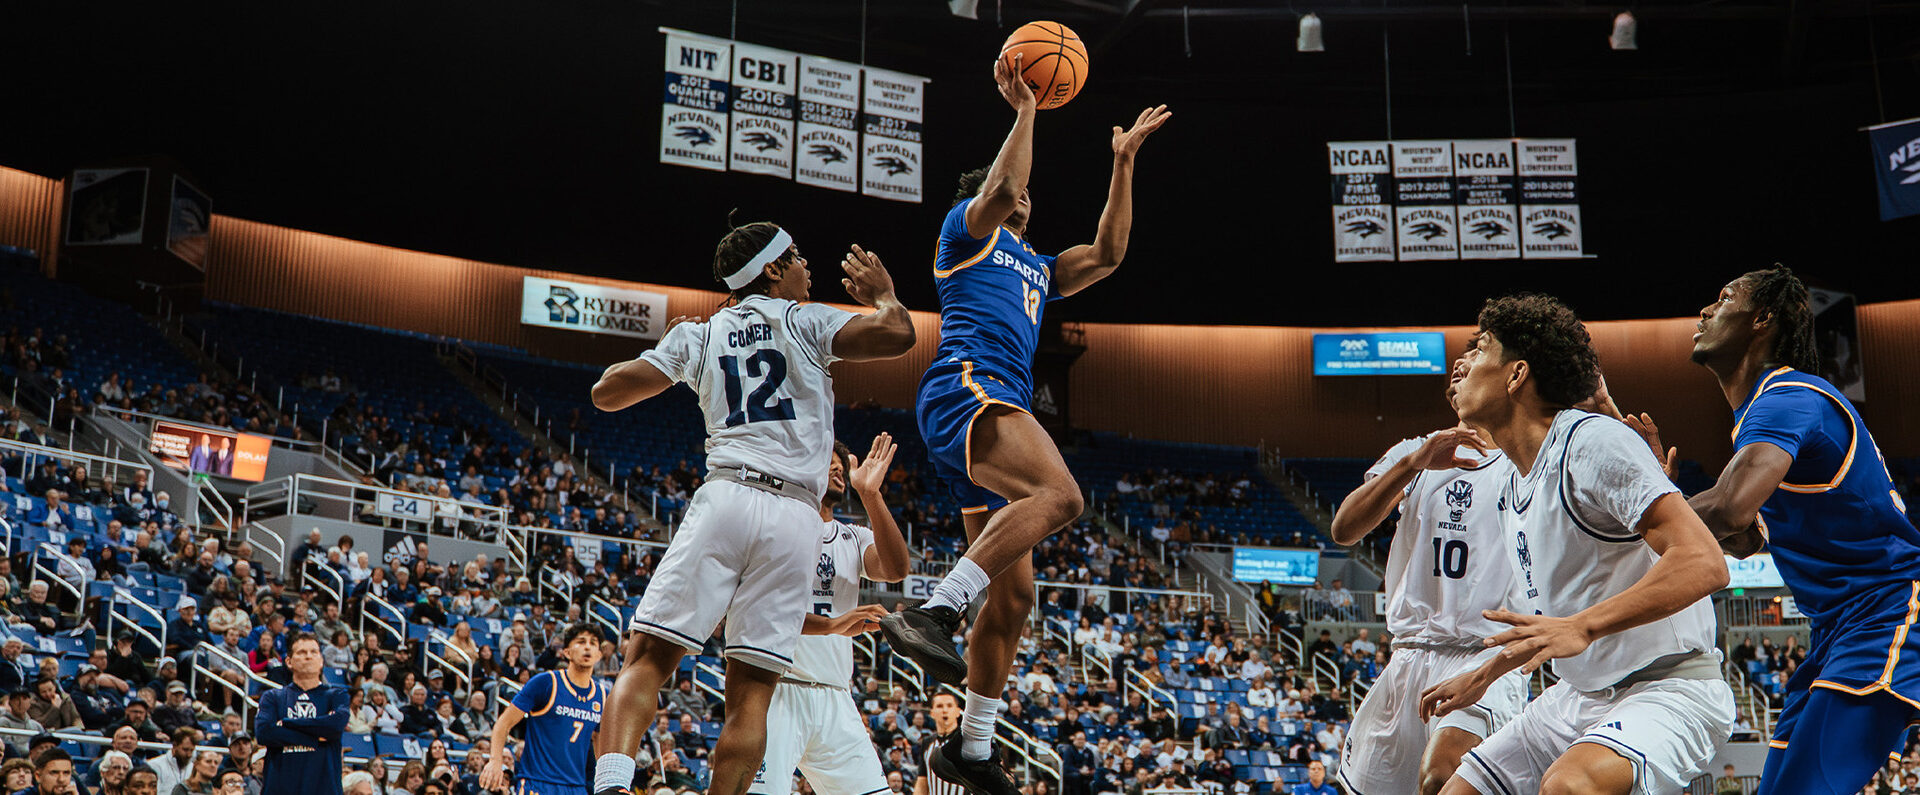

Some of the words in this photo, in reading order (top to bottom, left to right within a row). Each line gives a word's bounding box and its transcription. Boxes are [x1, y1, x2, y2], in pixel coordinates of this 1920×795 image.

[680, 46, 718, 71] NIT
[740, 57, 786, 85] CBI
[807, 66, 852, 81] MOUNTAIN
[681, 75, 710, 90] 2012
[817, 79, 842, 89] WEST
[872, 79, 916, 94] MOUNTAIN
[668, 82, 725, 104] QUARTER
[740, 87, 786, 107] 2016
[803, 86, 854, 102] CONFERENCE
[882, 91, 906, 101] WEST
[677, 96, 717, 111] FINALS
[733, 100, 793, 118] CHAMPIONS
[867, 98, 920, 115] TOURNAMENT
[668, 112, 722, 134] NEVADA
[735, 118, 789, 140] NEVADA
[801, 112, 855, 130] CHAMPIONS
[879, 116, 908, 131] 2017
[865, 123, 921, 142] CHAMPIONS
[801, 131, 853, 153] NEVADA
[1525, 145, 1568, 153] MOUNTAIN
[664, 147, 723, 163] BASKETBALL
[867, 143, 918, 165] NEVADA
[1332, 150, 1387, 166] NCAA
[1401, 147, 1443, 155] MOUNTAIN
[734, 152, 788, 169] BASKETBALL
[1411, 156, 1434, 164] WEST
[1458, 153, 1510, 168] NCAA
[799, 168, 854, 185] BASKETBALL
[1347, 174, 1375, 184] 2017
[1471, 175, 1499, 184] 2018
[865, 181, 919, 196] BASKETBALL
[1345, 183, 1378, 194] FIRST
[1399, 192, 1451, 200] CHAMPIONS
[1342, 194, 1382, 204] ROUND
[1338, 207, 1389, 224] NEVADA
[1401, 210, 1453, 225] NEVADA
[1463, 208, 1514, 224] NEVADA
[1525, 209, 1577, 225] NEVADA
[1337, 246, 1393, 255] BASKETBALL
[1401, 244, 1456, 253] BASKETBALL
[1463, 243, 1517, 252] BASKETBALL
[1525, 244, 1579, 252] BASKETBALL
[584, 296, 651, 318] RYDER
[1021, 279, 1041, 326] 12
[582, 312, 650, 334] HOMES
[728, 323, 773, 349] COMER
[718, 348, 797, 429] 12
[237, 450, 268, 464] DOLAN
[393, 497, 418, 515] 24
[1438, 521, 1467, 532] NEVADA
[1432, 537, 1469, 579] 10
[911, 578, 935, 597] 26
[555, 704, 601, 724] SPARTANS
[570, 721, 584, 744] 7
